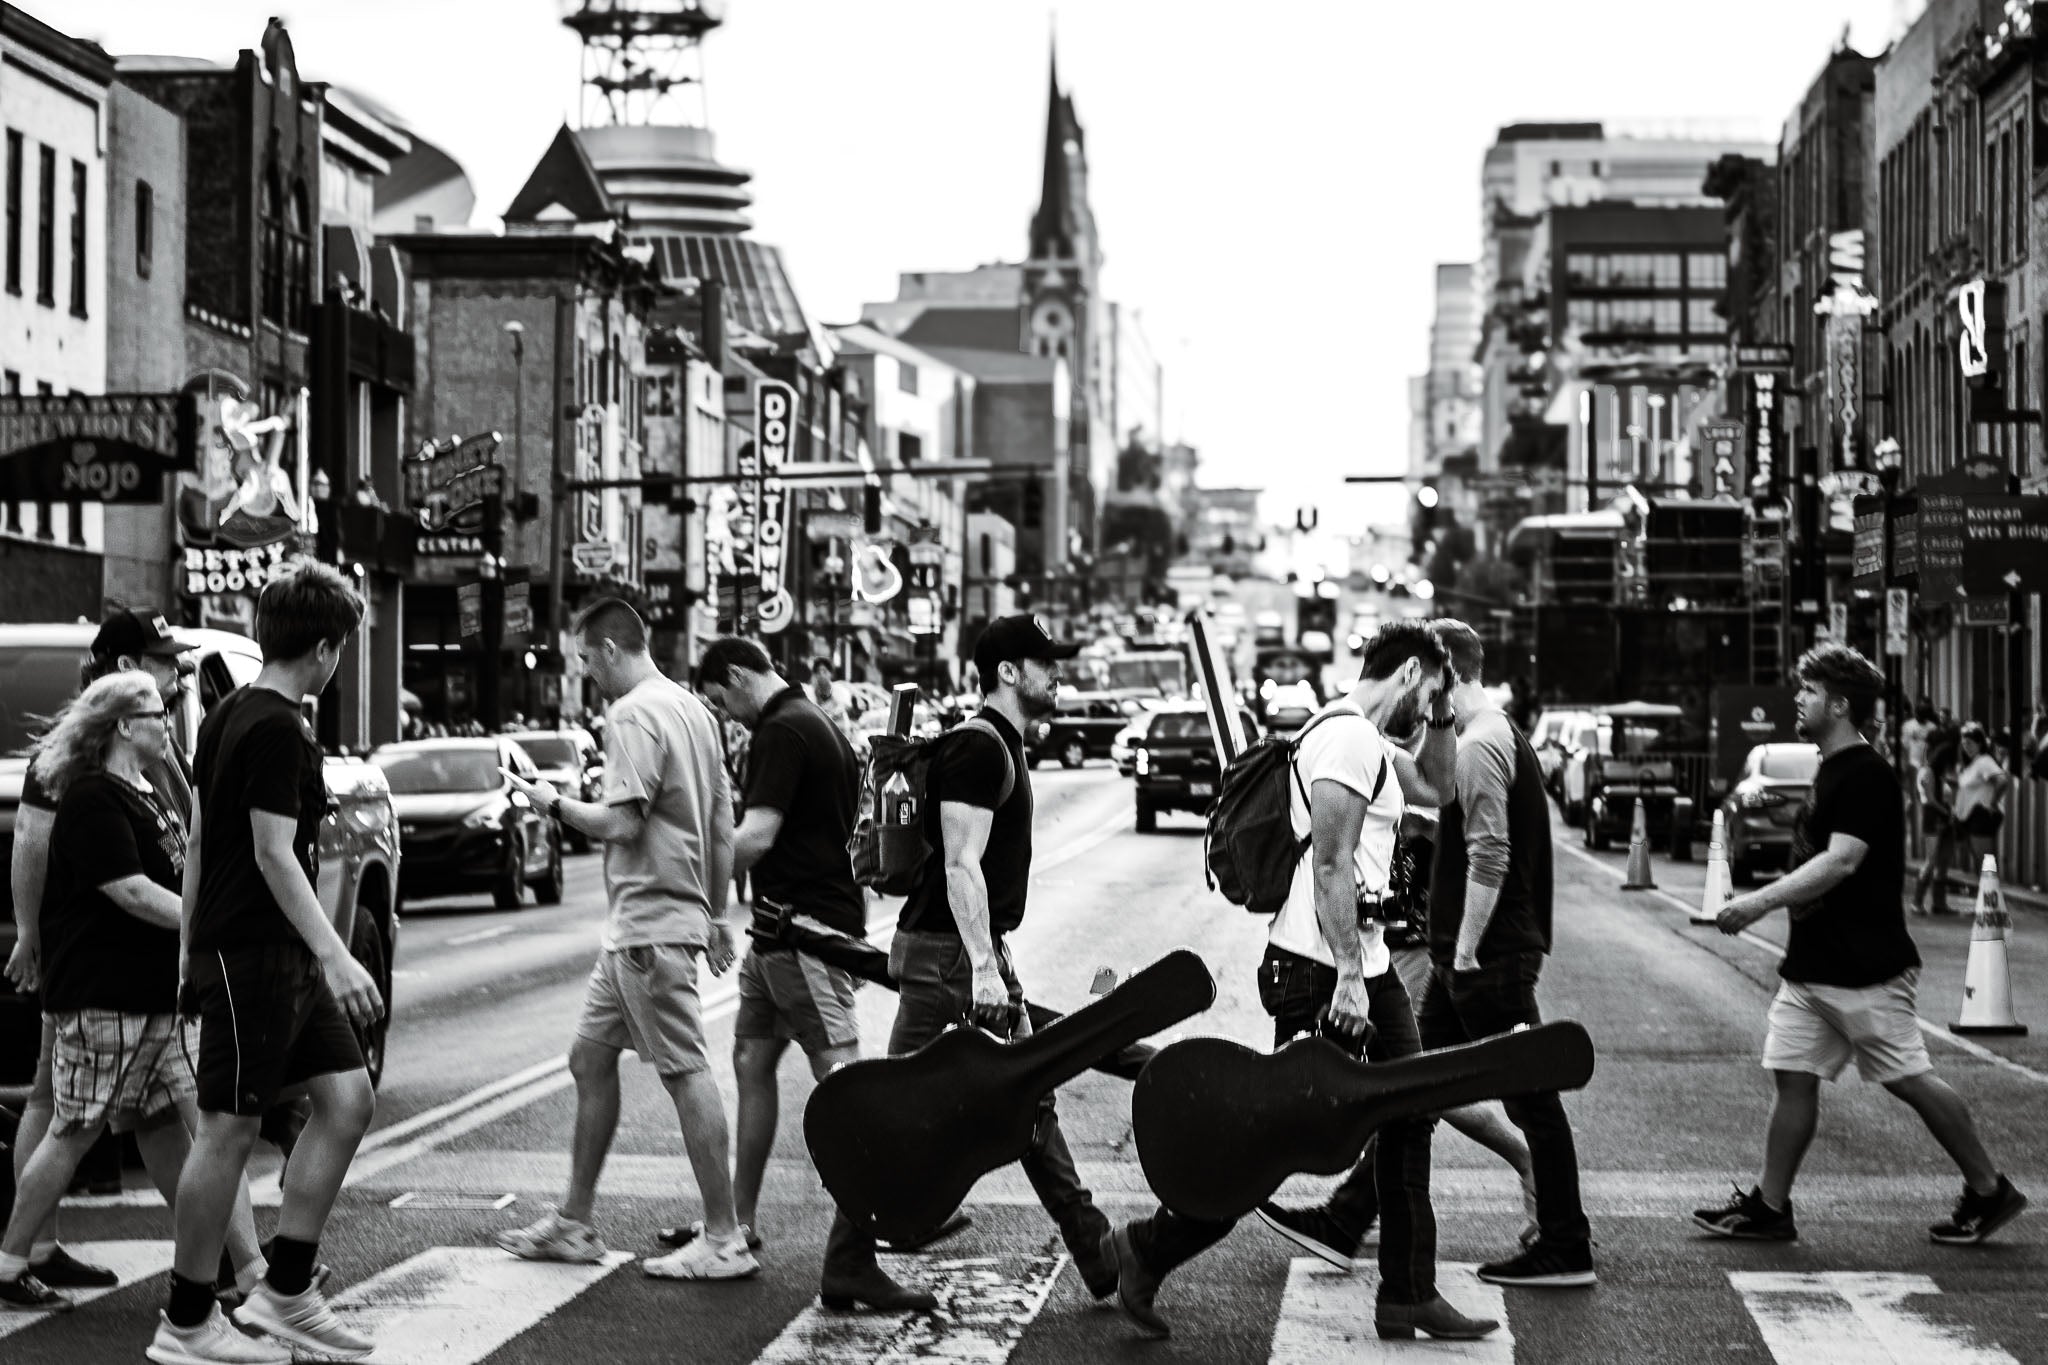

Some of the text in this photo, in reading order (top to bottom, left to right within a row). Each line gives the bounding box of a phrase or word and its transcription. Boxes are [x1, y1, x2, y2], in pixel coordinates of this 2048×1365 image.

[760, 393, 786, 592] DOWNTOWN
[1967, 506, 2022, 521] Korean
[1967, 524, 2001, 539] Vets
[184, 541, 285, 571] BETTY
[1983, 890, 1998, 909] NO
